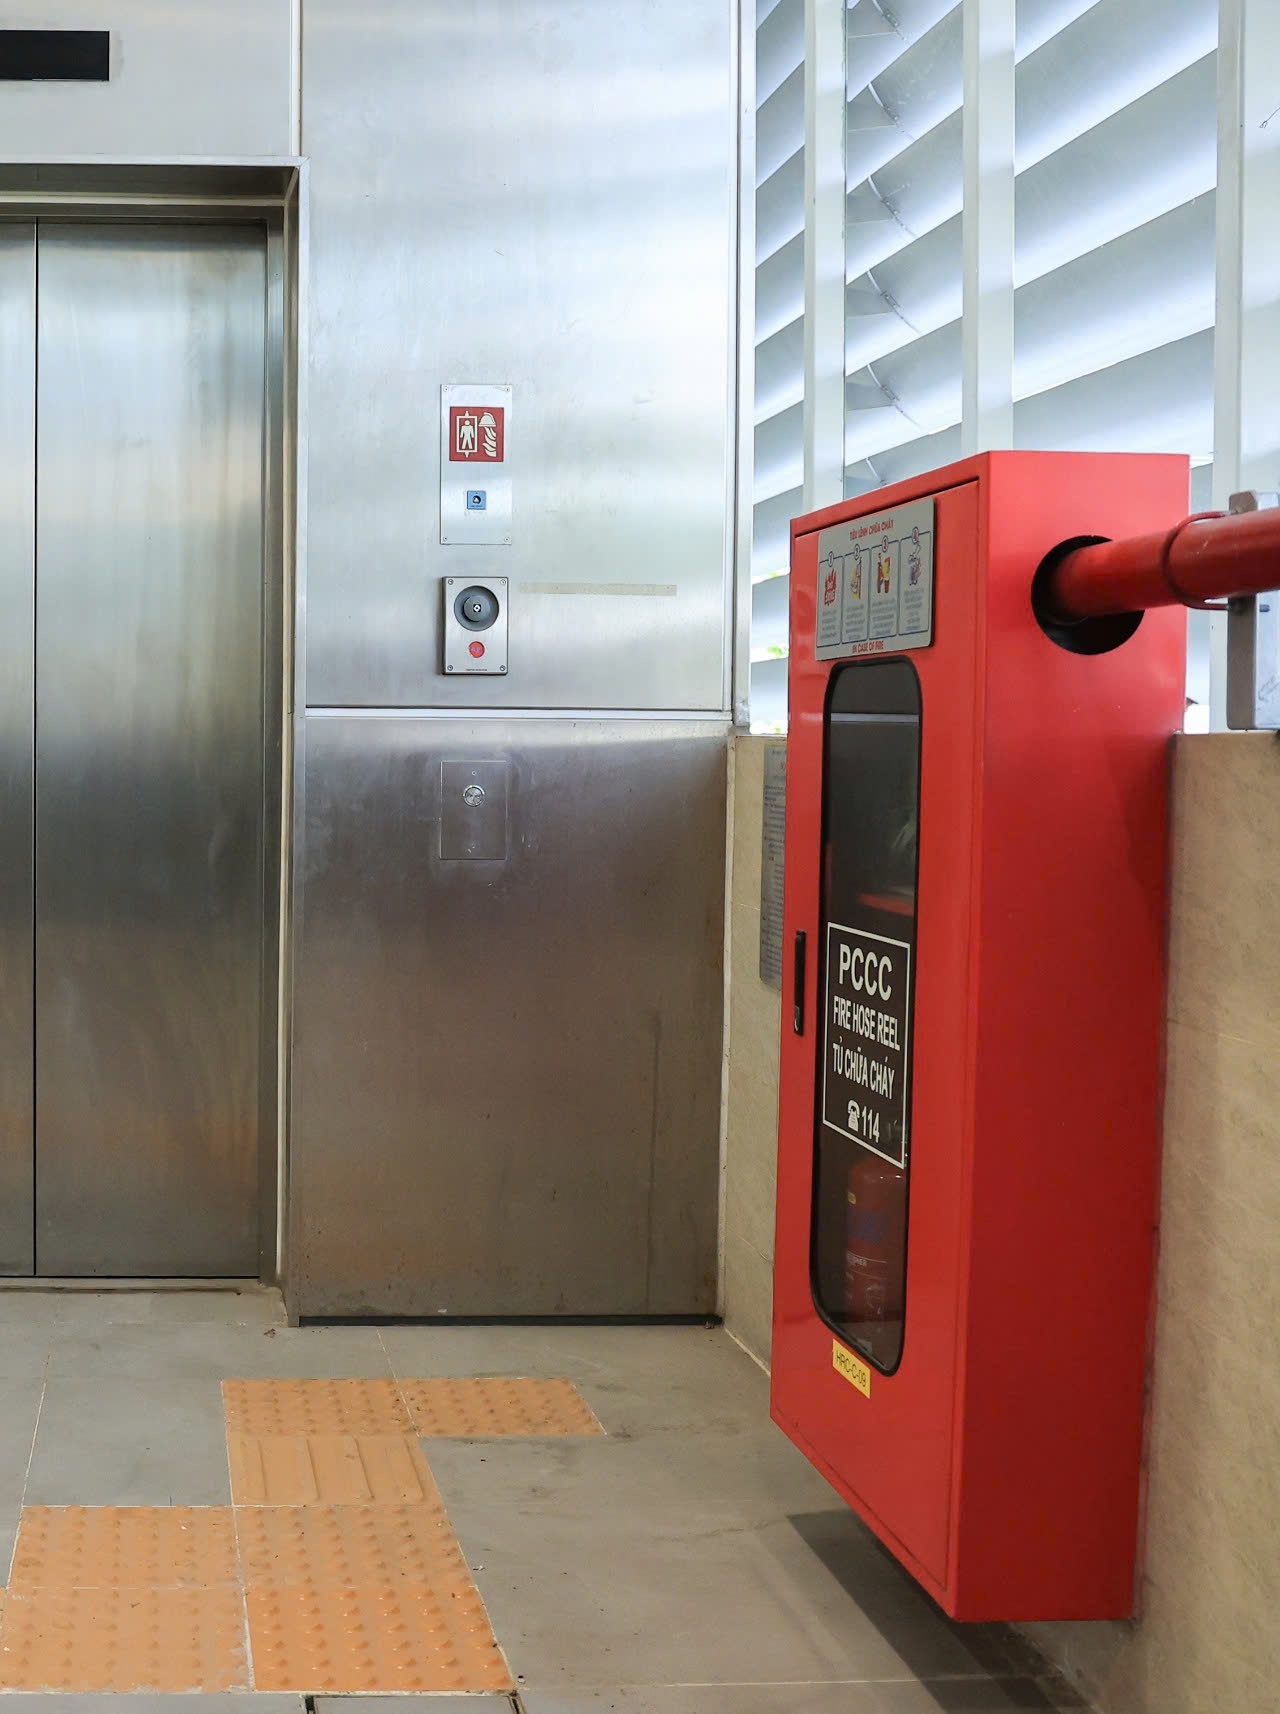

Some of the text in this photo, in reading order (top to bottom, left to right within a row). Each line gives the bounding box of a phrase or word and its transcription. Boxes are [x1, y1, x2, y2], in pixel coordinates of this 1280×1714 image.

[858, 642, 868, 653] CASE
[838, 943, 893, 1001] PCCC
[833, 995, 900, 1051] FIRE HOSE REEL
[833, 1035, 895, 1100] TỦ CHỮA CHÁY
[861, 1105, 880, 1143] 114
[836, 1350, 866, 1387] HRC-C-09
